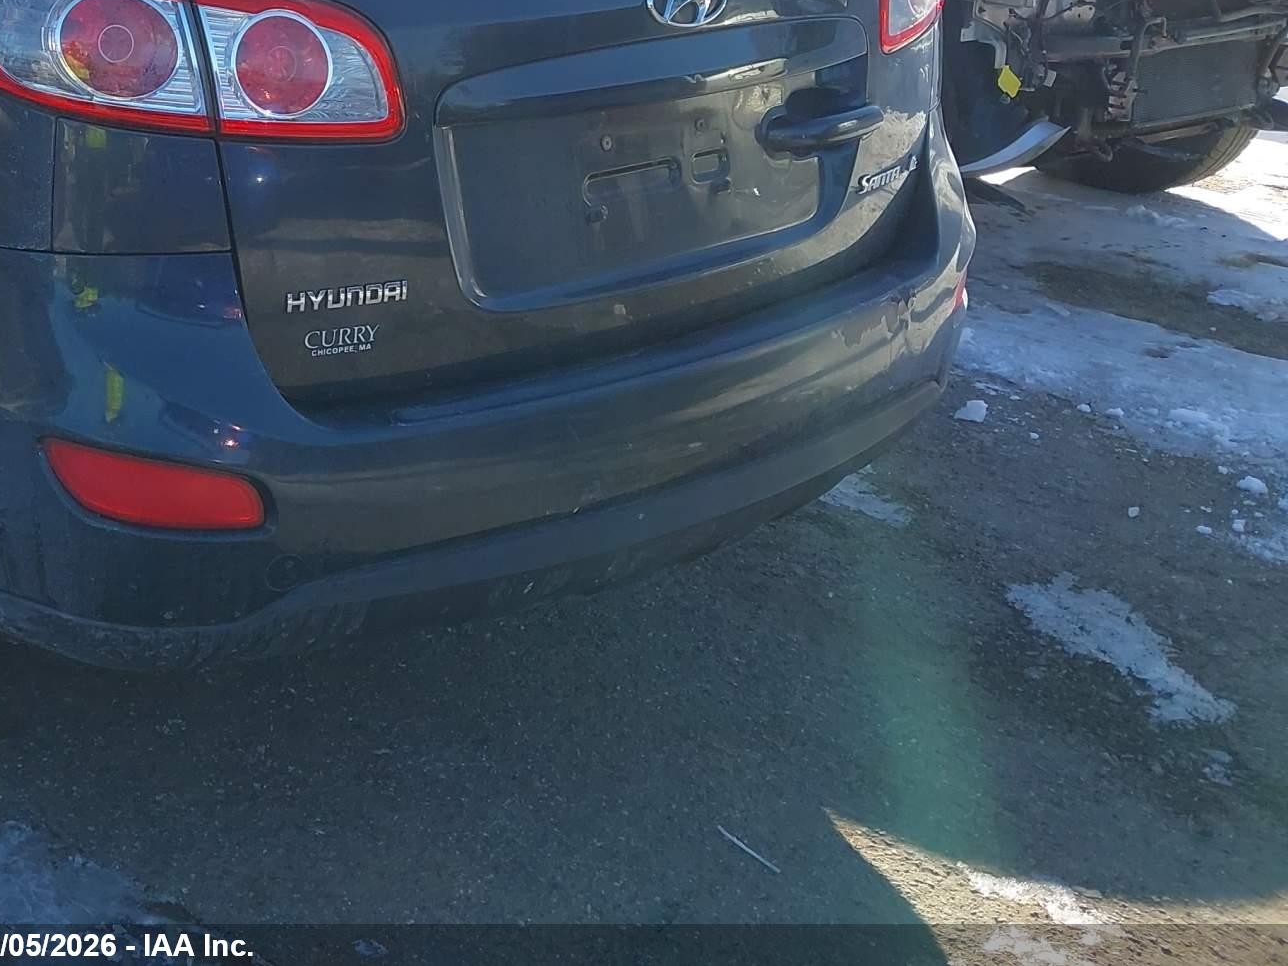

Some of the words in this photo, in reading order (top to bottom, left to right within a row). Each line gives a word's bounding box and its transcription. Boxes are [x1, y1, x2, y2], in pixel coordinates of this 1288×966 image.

[287, 280, 408, 313] HYUNDAI
[304, 324, 380, 349] CURRY
[311, 345, 358, 356] CHICOPEE,
[358, 343, 372, 351] MA
